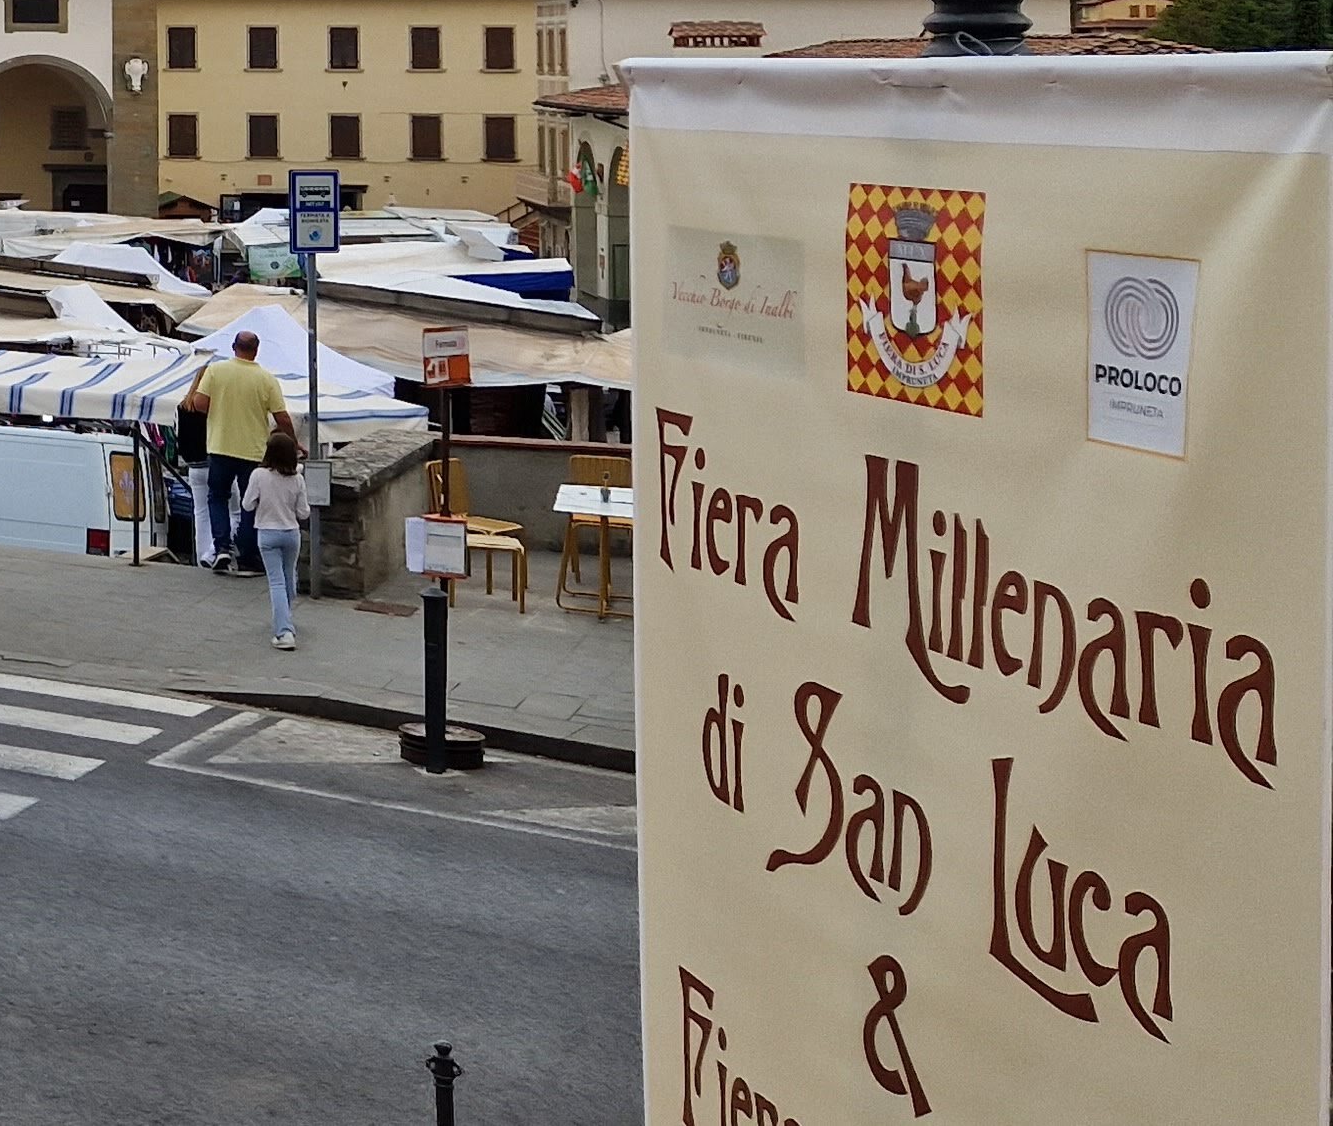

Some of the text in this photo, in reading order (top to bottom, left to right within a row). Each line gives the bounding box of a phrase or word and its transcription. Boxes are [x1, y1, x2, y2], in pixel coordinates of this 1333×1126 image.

[878, 331, 903, 373] FIERA
[905, 362, 917, 376] DI
[928, 341, 951, 370] LUCA
[892, 366, 939, 386] IMPRUNETA
[1095, 363, 1182, 396] PROLOCO
[1109, 399, 1164, 418] IMPRUNETA
[655, 407, 1279, 791] Fiera Millenaria
[701, 673, 1173, 1044] di San Luca
[862, 954, 933, 1119] &
